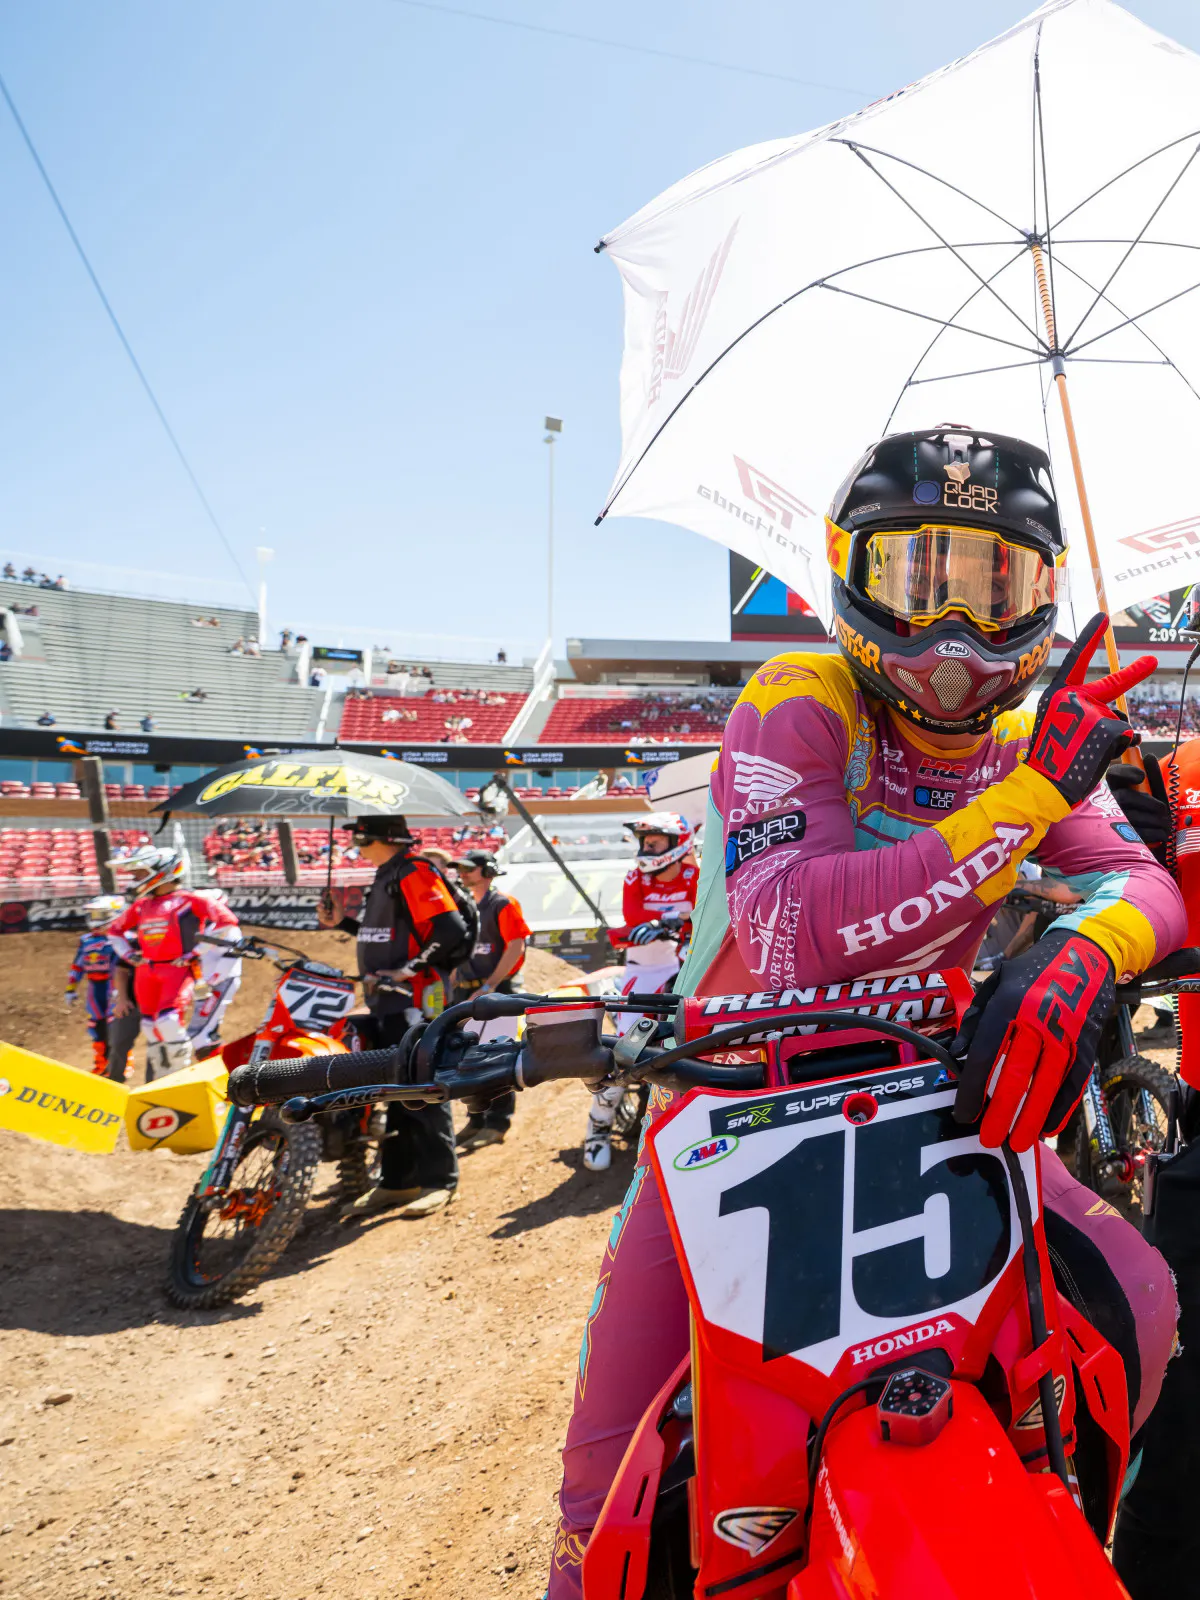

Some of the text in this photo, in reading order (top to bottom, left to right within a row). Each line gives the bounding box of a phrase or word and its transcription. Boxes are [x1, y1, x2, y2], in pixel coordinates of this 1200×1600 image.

[943, 494, 998, 514] LOCK
[944, 482, 997, 500] QUAD
[939, 641, 967, 654] Arai
[1149, 628, 1177, 642] 2:09
[1036, 692, 1085, 775] FLY
[917, 757, 967, 780] HRC
[200, 763, 405, 808] GALFER
[931, 790, 957, 800] QUA
[728, 797, 804, 828] ONDA
[930, 800, 953, 809] LOC
[738, 815, 799, 846] QUAD
[837, 823, 1029, 957] HONDA
[286, 983, 350, 1021] 72
[703, 972, 948, 1015] RENTHAL
[1037, 947, 1091, 1042] FLY
[15, 1085, 120, 1127] DUNLOP
[727, 1107, 772, 1130] SMX
[145, 1115, 174, 1131] D
[685, 1139, 728, 1167] AMA
[719, 1105, 1012, 1363] 15
[851, 1319, 956, 1365] HONDA
